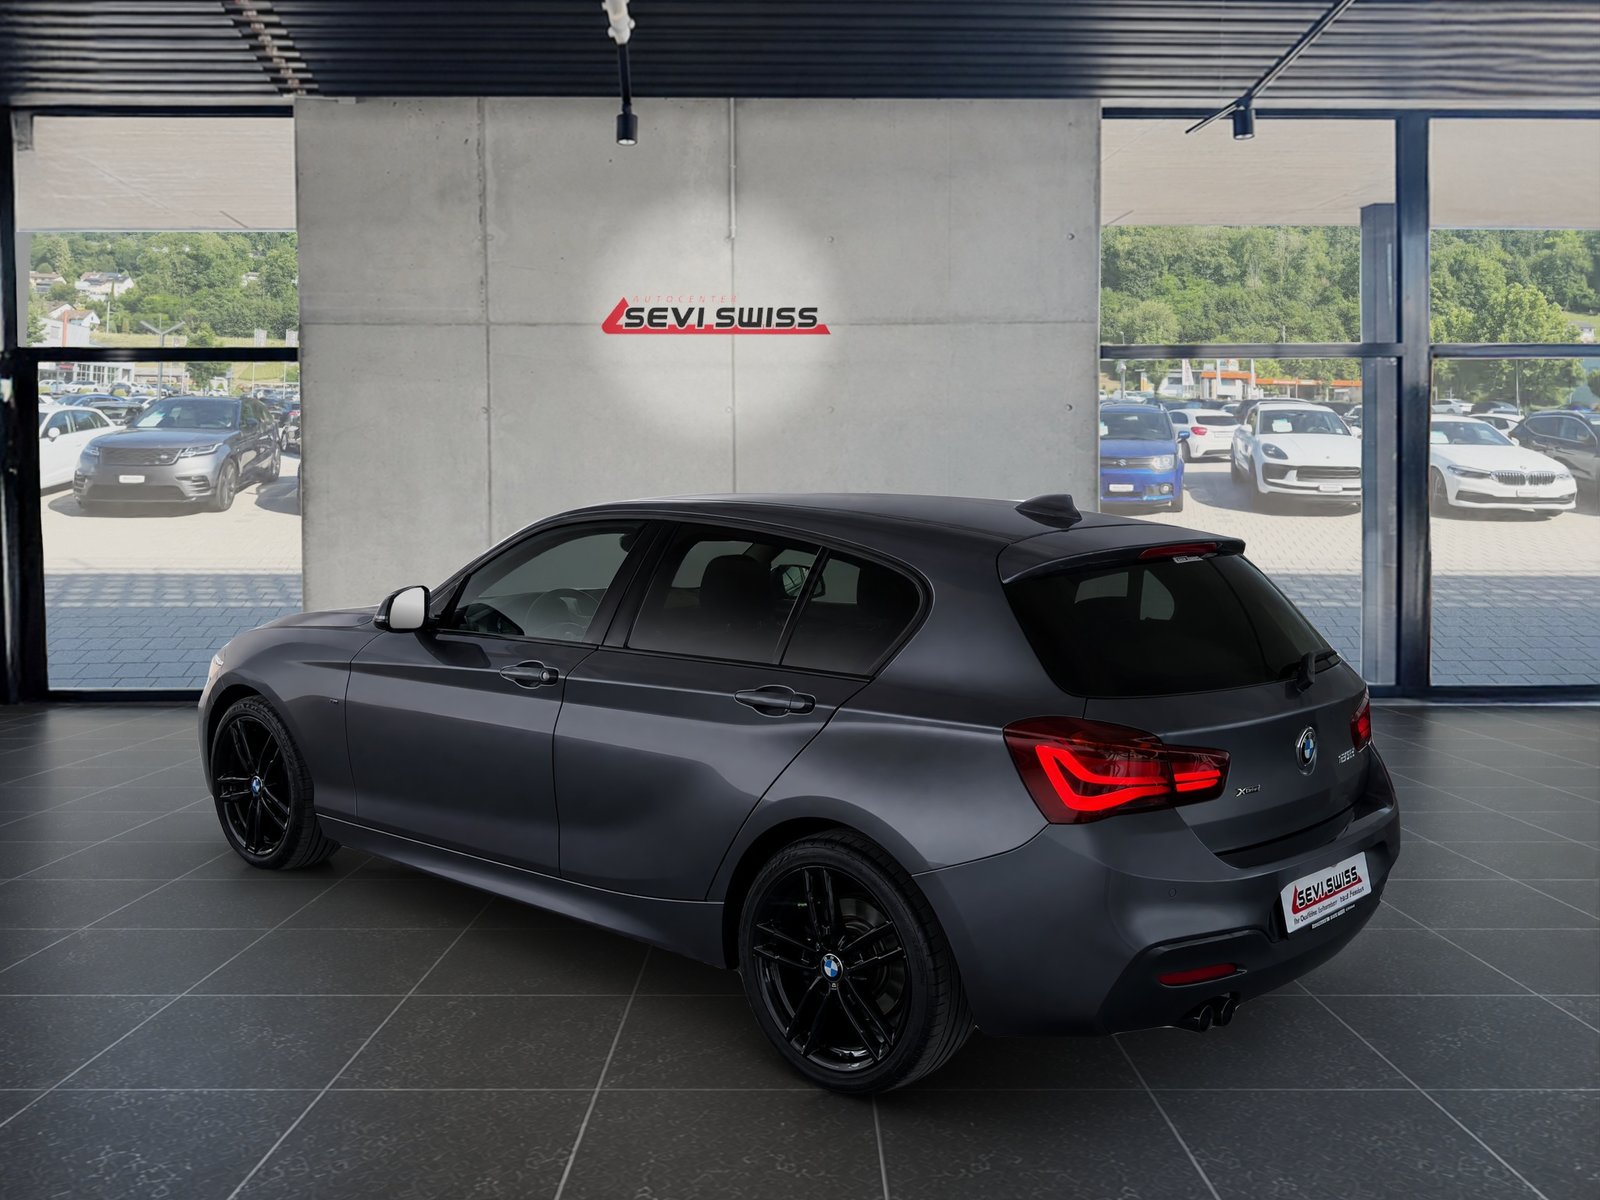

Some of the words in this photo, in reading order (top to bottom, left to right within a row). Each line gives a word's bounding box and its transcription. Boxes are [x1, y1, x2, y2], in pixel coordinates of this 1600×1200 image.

[632, 295, 738, 304] AUTOCENTER
[624, 307, 705, 328] SEVI
[715, 307, 818, 328] SWISS
[1297, 881, 1324, 907] SEVI
[1326, 866, 1358, 893] SWISS
